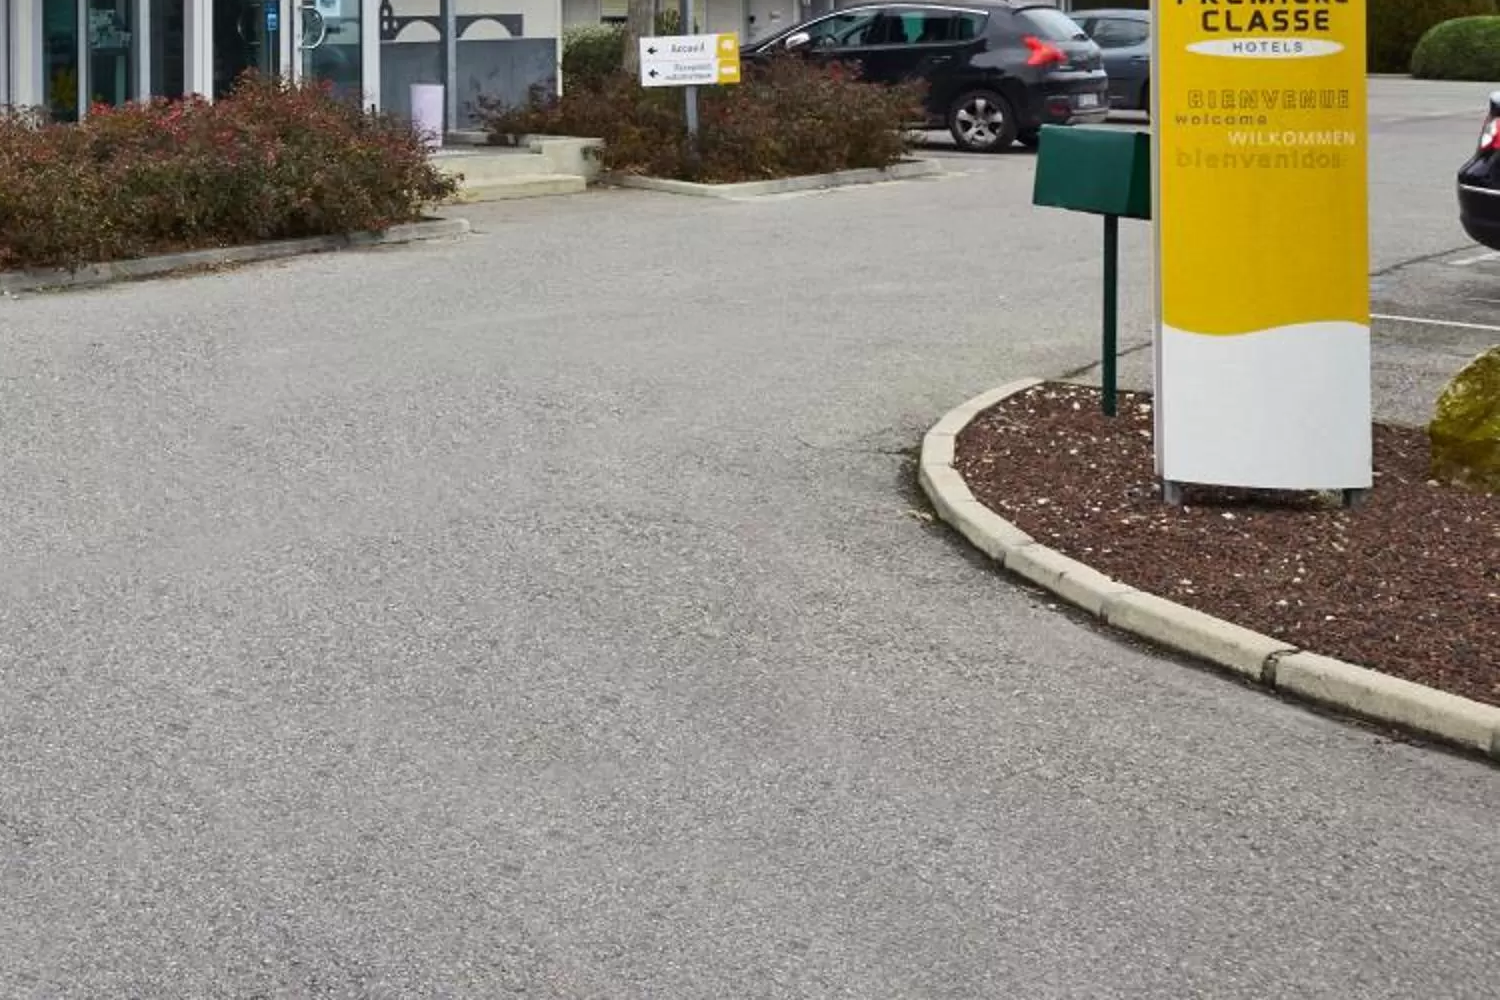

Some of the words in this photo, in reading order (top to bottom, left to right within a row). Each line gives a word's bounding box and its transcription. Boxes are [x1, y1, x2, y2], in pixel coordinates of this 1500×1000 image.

[1202, 9, 1330, 32] CLASSE
[1232, 40, 1304, 54] HOTELS
[1187, 88, 1350, 110] BIENVENUE
[1175, 113, 1268, 126] welcome
